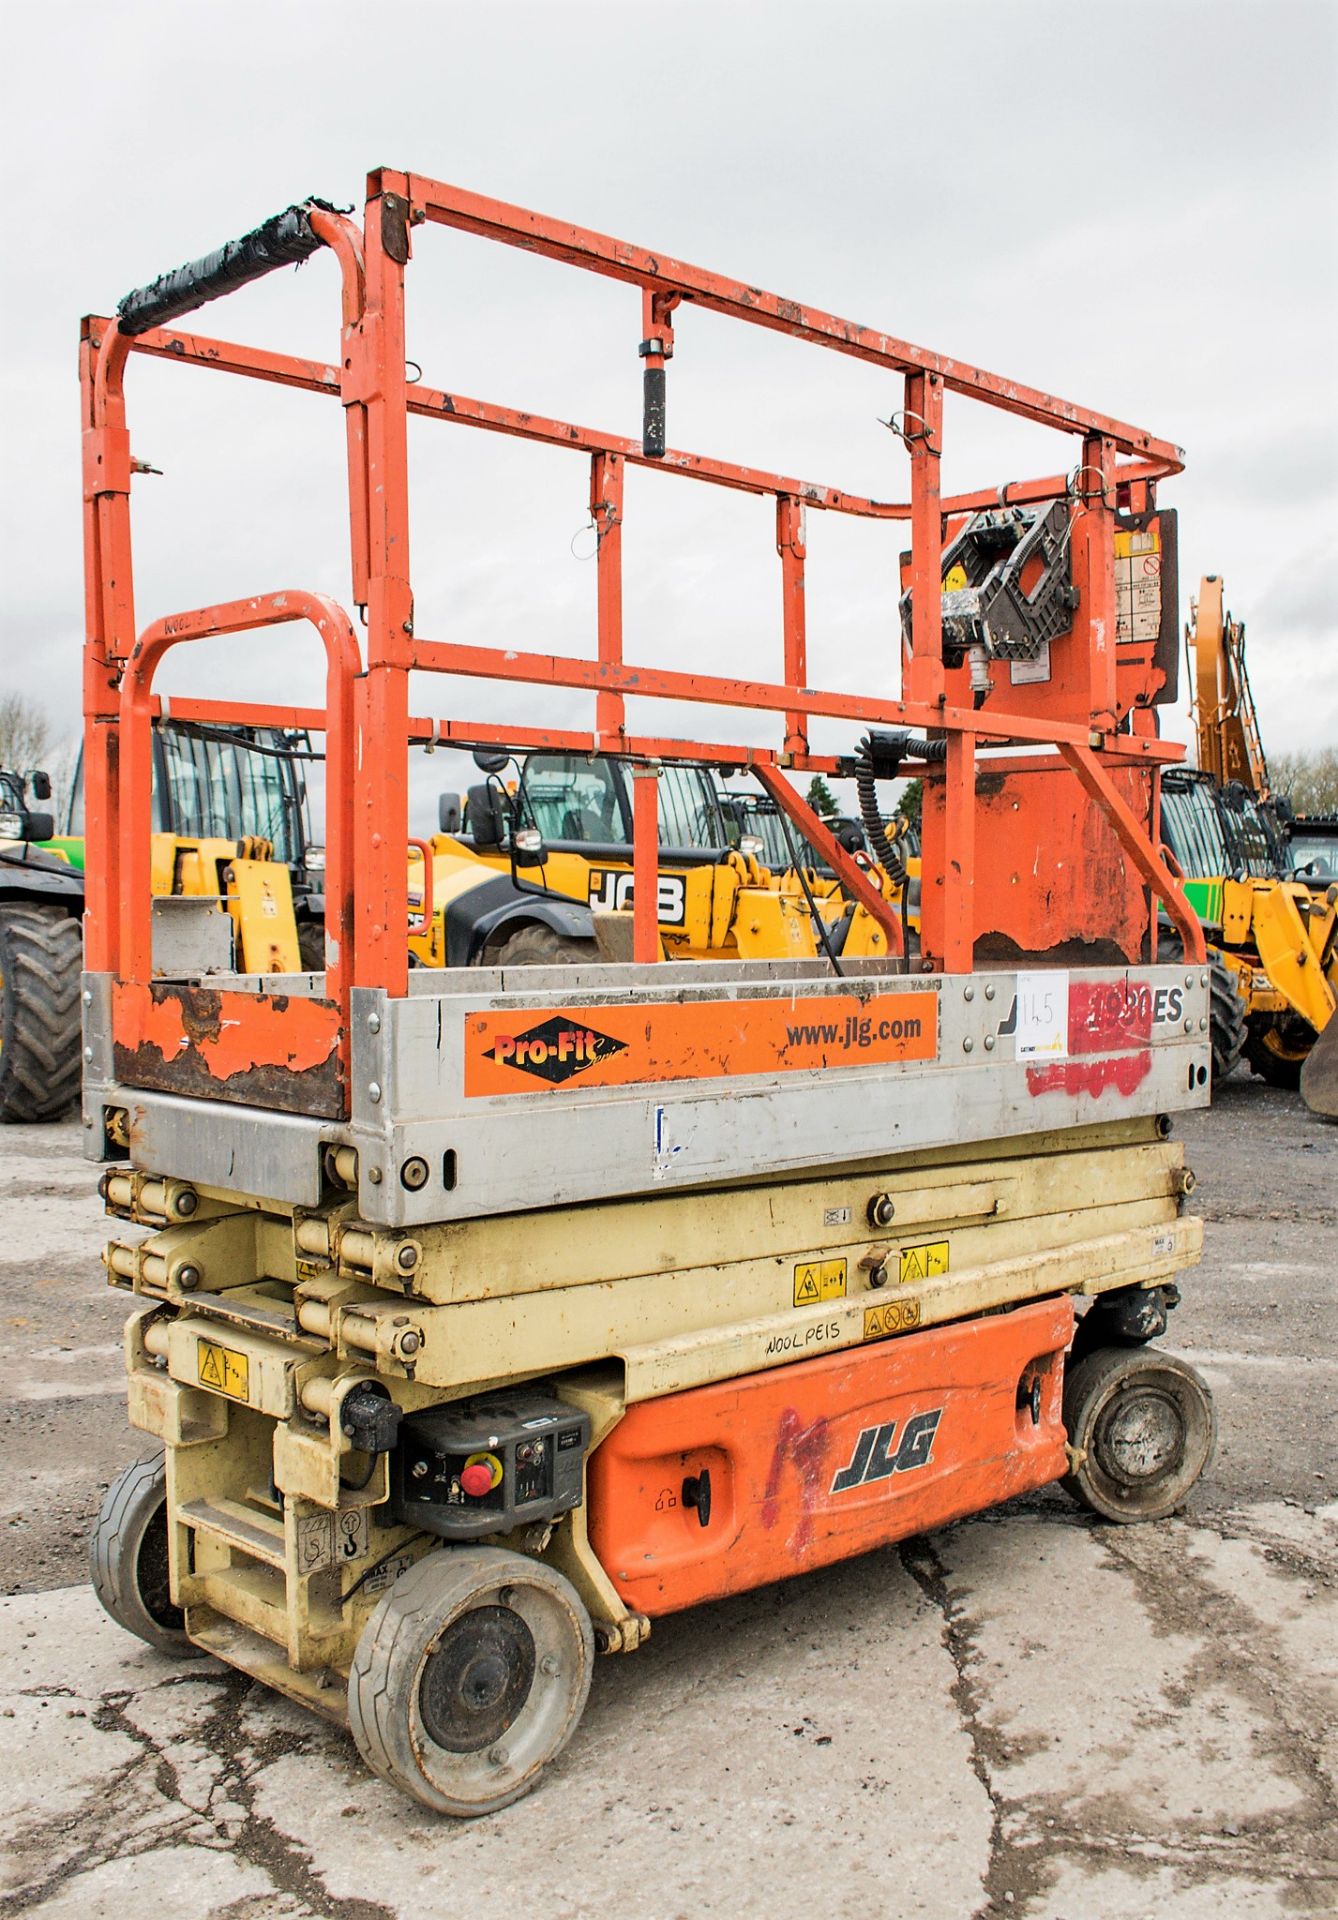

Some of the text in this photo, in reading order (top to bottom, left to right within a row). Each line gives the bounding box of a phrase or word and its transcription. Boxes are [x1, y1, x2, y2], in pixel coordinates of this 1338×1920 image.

[494, 1030, 597, 1066] Pro-Fit
[786, 1016, 922, 1050] www.jlg.com
[829, 1407, 943, 1495] JLG
